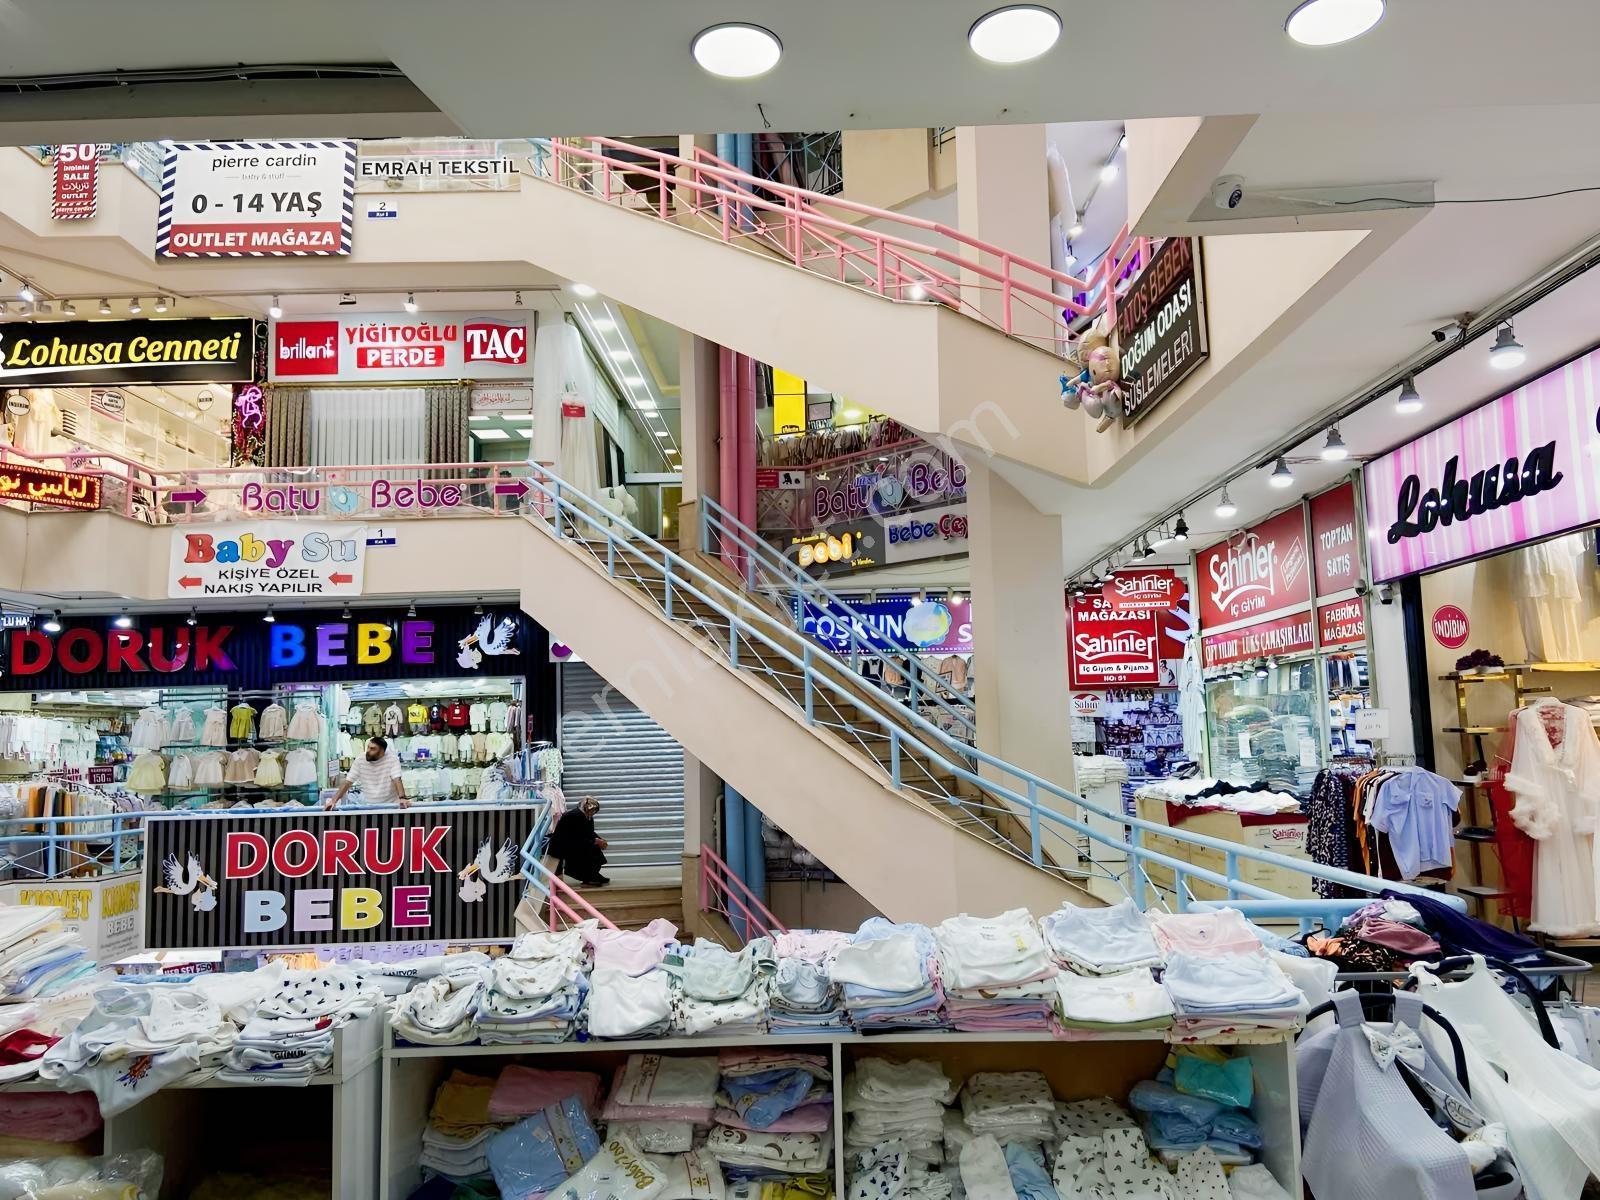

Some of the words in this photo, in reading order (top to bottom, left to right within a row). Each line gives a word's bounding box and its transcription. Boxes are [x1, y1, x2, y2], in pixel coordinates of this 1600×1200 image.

[59, 143, 96, 162] 50
[212, 155, 259, 172] pierre
[265, 153, 317, 168] cardin
[362, 161, 432, 176] EMRAH
[438, 156, 520, 174] TEKSTİL
[191, 194, 208, 213] 0
[233, 193, 264, 213] 14
[271, 191, 322, 217] YAŞ
[379, 201, 386, 210] 2
[174, 232, 245, 248] OUTLET
[251, 227, 335, 247] MAĞAZA
[1118, 282, 1149, 342] FATOŞ
[1149, 237, 1193, 303] BEBEK
[345, 322, 457, 345] YİĞİTOĞLU
[1121, 321, 1156, 380] DOĞUM
[1157, 278, 1193, 337] ODASI
[7, 338, 125, 367] Lohusa
[128, 332, 242, 362] Cenneti
[279, 337, 334, 360] brillant
[466, 328, 525, 363] TAÇ
[366, 348, 436, 367] PERDE
[1123, 320, 1194, 417] SÜSLEMELERİ
[241, 482, 321, 511] Batu
[370, 478, 463, 509] Bebe
[814, 483, 872, 518] Batu
[911, 456, 967, 497] Beb
[1387, 440, 1564, 544] Lohusa
[378, 529, 383, 537] 1
[888, 520, 936, 544] Bebe
[1320, 522, 1353, 550] TOPTAN
[183, 533, 294, 568] Baby
[301, 532, 358, 563] Su
[218, 567, 270, 581] KİŞİYE
[276, 566, 320, 579] ÖZEL
[1327, 555, 1351, 577] SATIŞ
[258, 582, 323, 594] YAPILIR
[1093, 598, 1112, 608] SA
[1241, 596, 1266, 614] GİYİM
[1325, 603, 1361, 624] FABRİKA
[1078, 610, 1151, 621] MAĞAZASI
[1434, 615, 1467, 636] İNDİRİM
[1324, 620, 1366, 642] MAĞAZASI
[11, 625, 238, 676] DORUK
[270, 620, 436, 669] BEBE
[225, 825, 452, 880] DORUK
[244, 884, 432, 933] BEBE
[107, 917, 135, 938] BEBE
